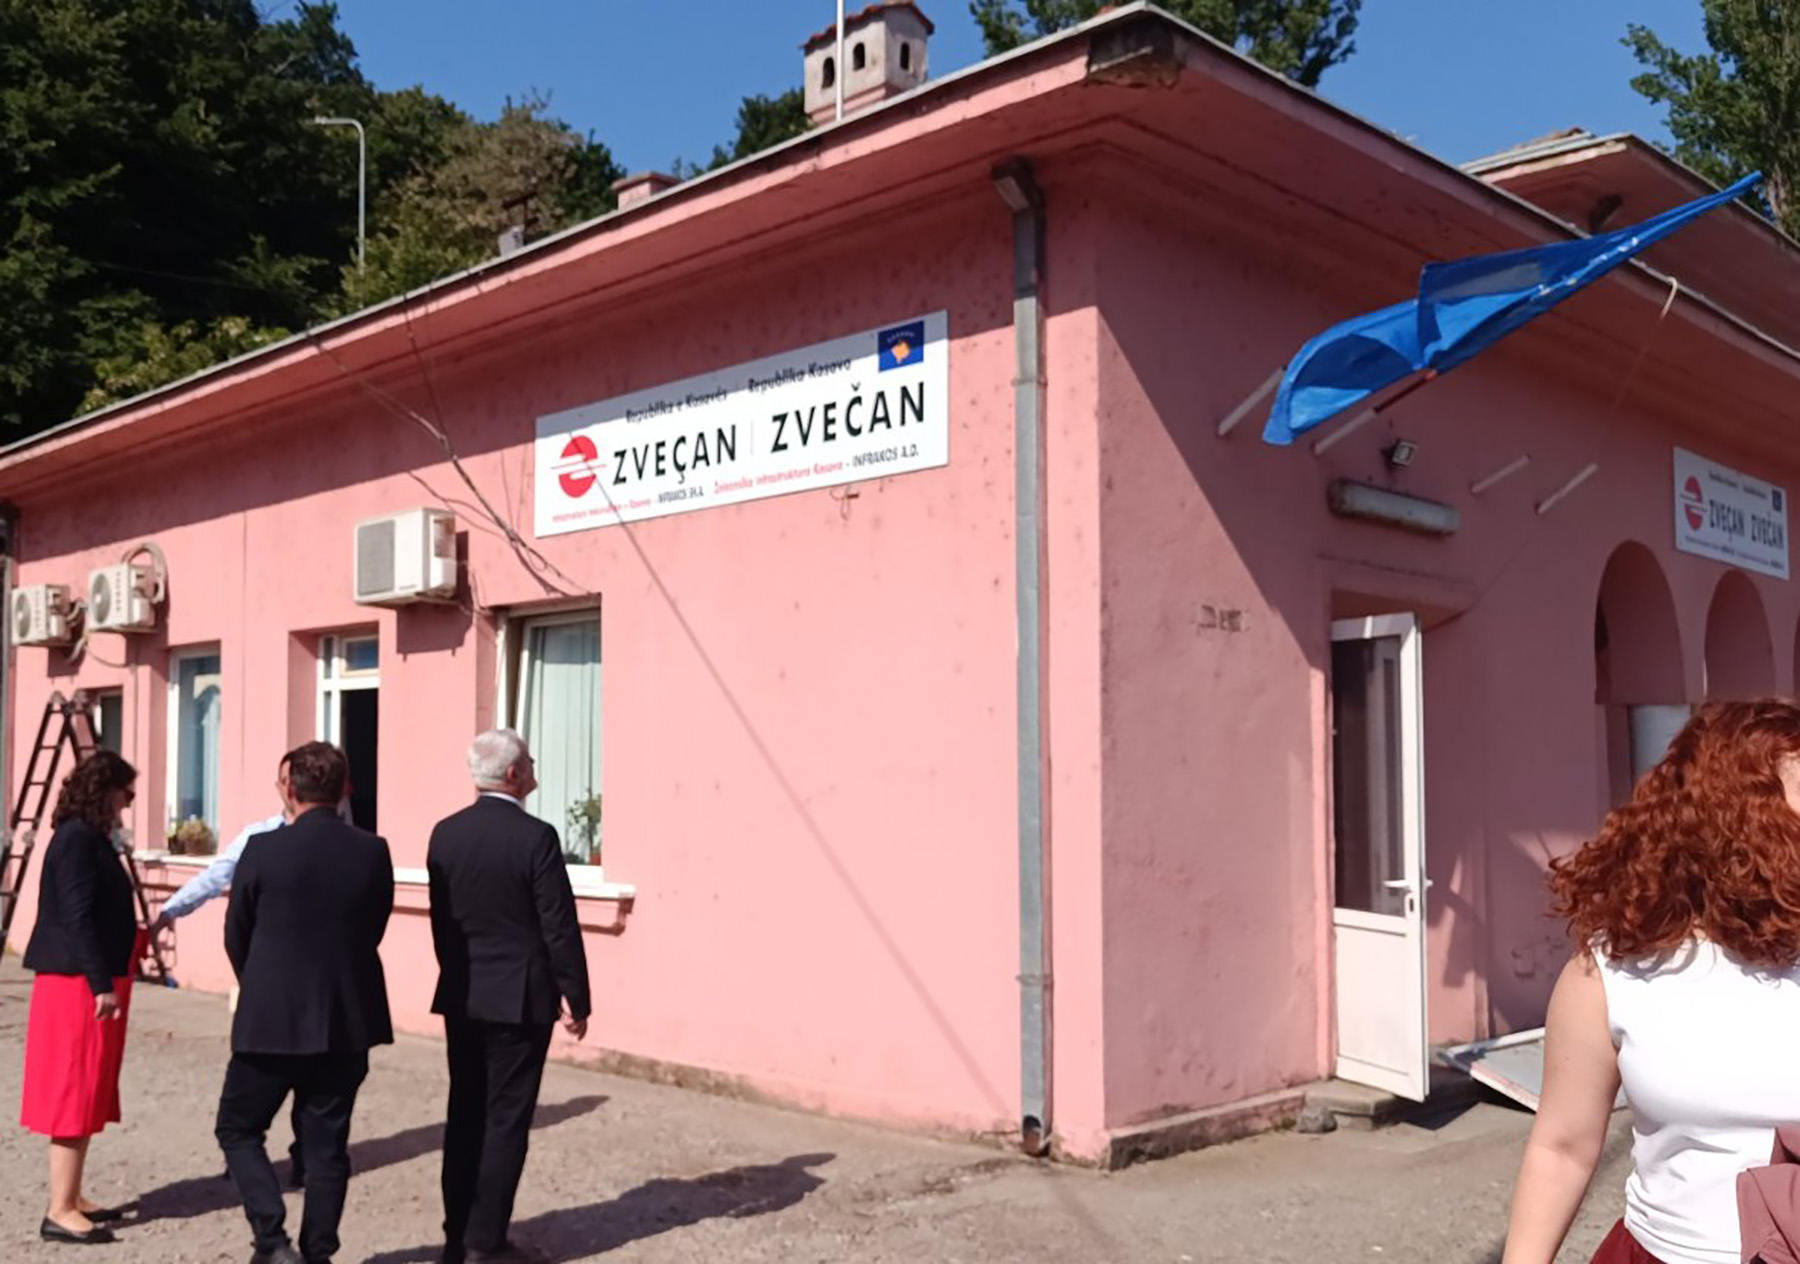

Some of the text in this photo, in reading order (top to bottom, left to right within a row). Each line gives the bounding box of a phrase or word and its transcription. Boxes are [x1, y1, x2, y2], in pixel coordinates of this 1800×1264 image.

[748, 367, 805, 393] Republika
[771, 381, 924, 453] ZVEČAN
[612, 424, 736, 484] ZVEÇAN
[853, 447, 898, 467] INFRAKOS
[1709, 499, 1745, 542] ZVEÇAN
